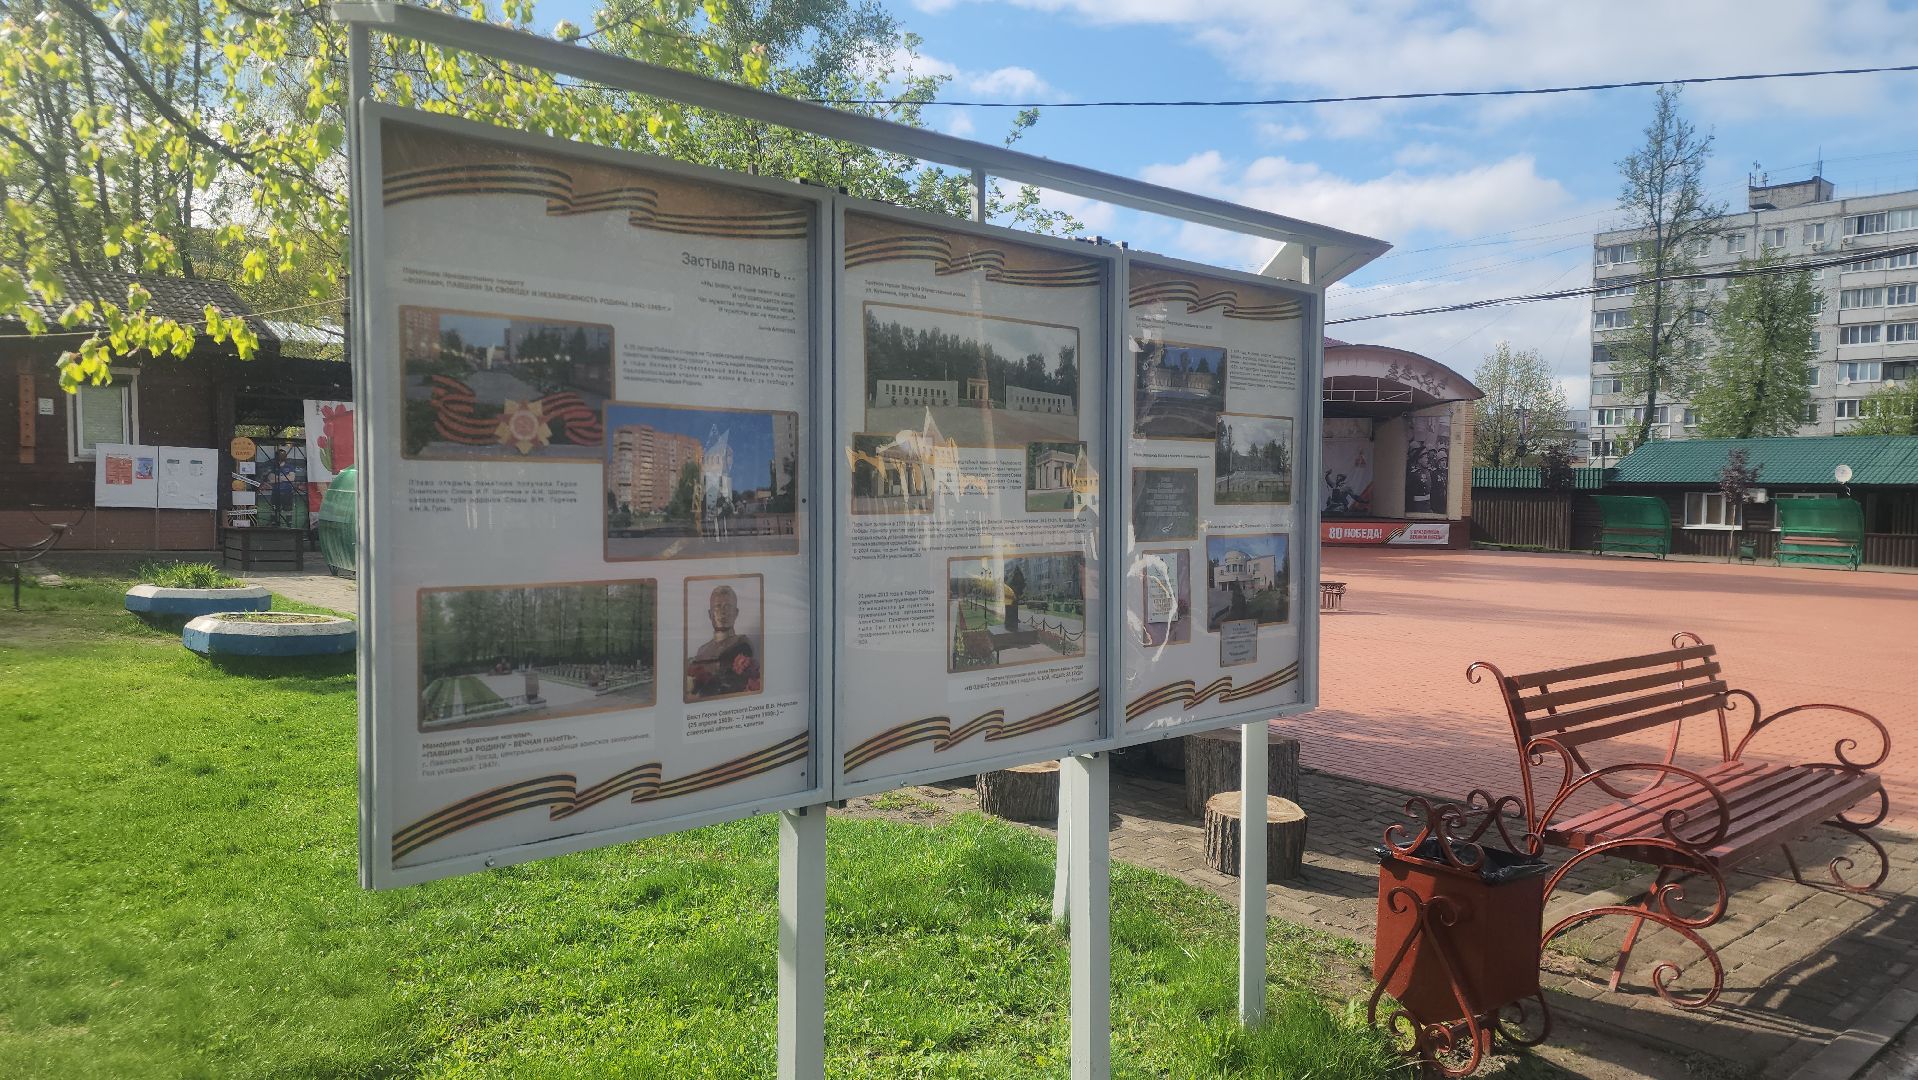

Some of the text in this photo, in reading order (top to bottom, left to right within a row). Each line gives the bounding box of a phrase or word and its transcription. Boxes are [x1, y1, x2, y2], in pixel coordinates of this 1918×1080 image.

[681, 251, 735, 271] Застыла
[738, 262, 781, 278] память
[1329, 527, 1383, 540] 80 ПОБЕДА!
[475, 742, 507, 752] РОДИНУ
